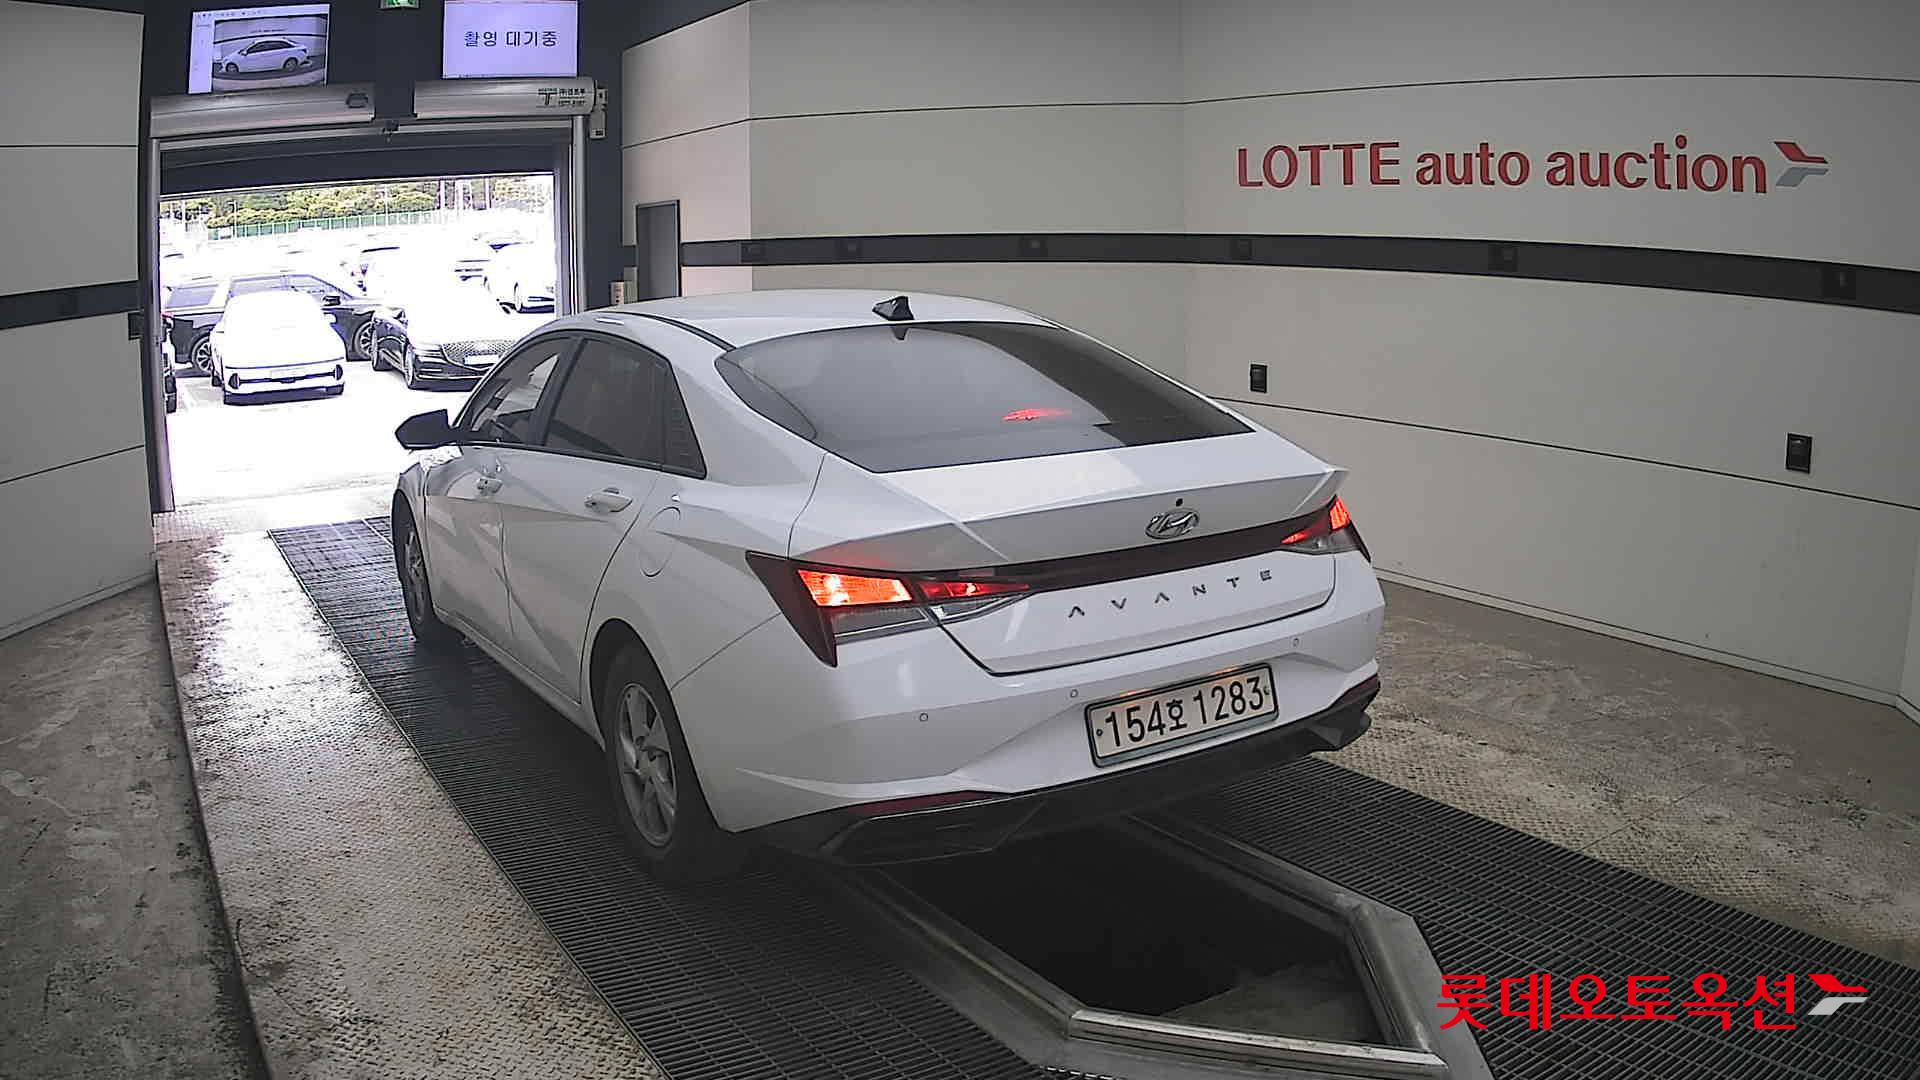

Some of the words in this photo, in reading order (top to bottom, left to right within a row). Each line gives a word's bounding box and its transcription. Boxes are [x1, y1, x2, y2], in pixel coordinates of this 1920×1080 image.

[464, 30, 498, 48] 촬영
[505, 30, 558, 48] 대기중
[1237, 142, 1400, 189] LOTTE
[1417, 143, 1532, 188] auto
[1547, 135, 1766, 193] auction
[1068, 569, 1273, 618] AVANTE
